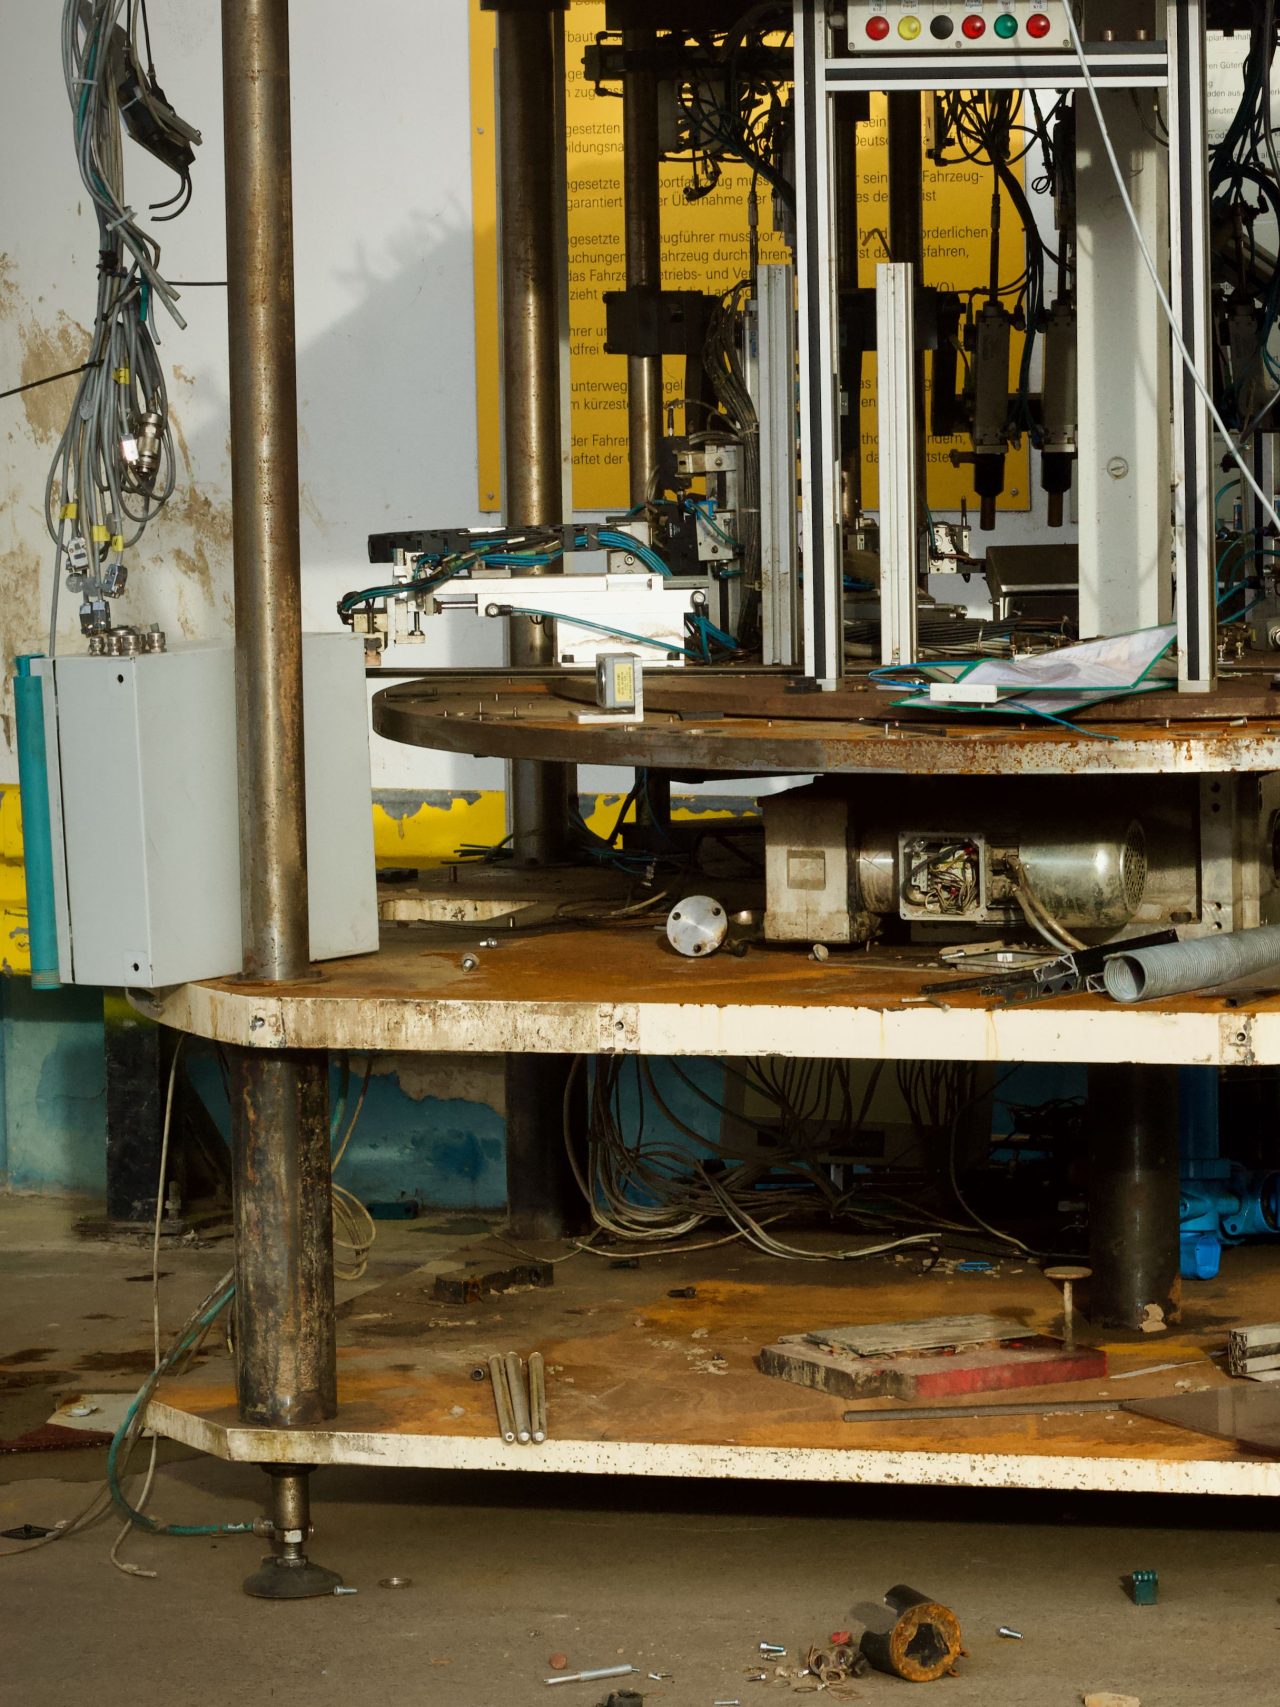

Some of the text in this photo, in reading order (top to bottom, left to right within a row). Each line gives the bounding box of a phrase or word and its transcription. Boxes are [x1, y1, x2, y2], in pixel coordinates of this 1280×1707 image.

[566, 140, 624, 155] ildungsna
[567, 179, 620, 193] gesetzte
[568, 233, 620, 248] gesetzte
[922, 225, 988, 240] orderlichen
[568, 252, 626, 266] uchungen
[660, 250, 709, 264] ahrzeug
[922, 243, 970, 259] sfahren,
[706, 266, 728, 280] und
[569, 287, 598, 301] zieht
[571, 380, 628, 395] unterweg
[604, 451, 623, 465] der
